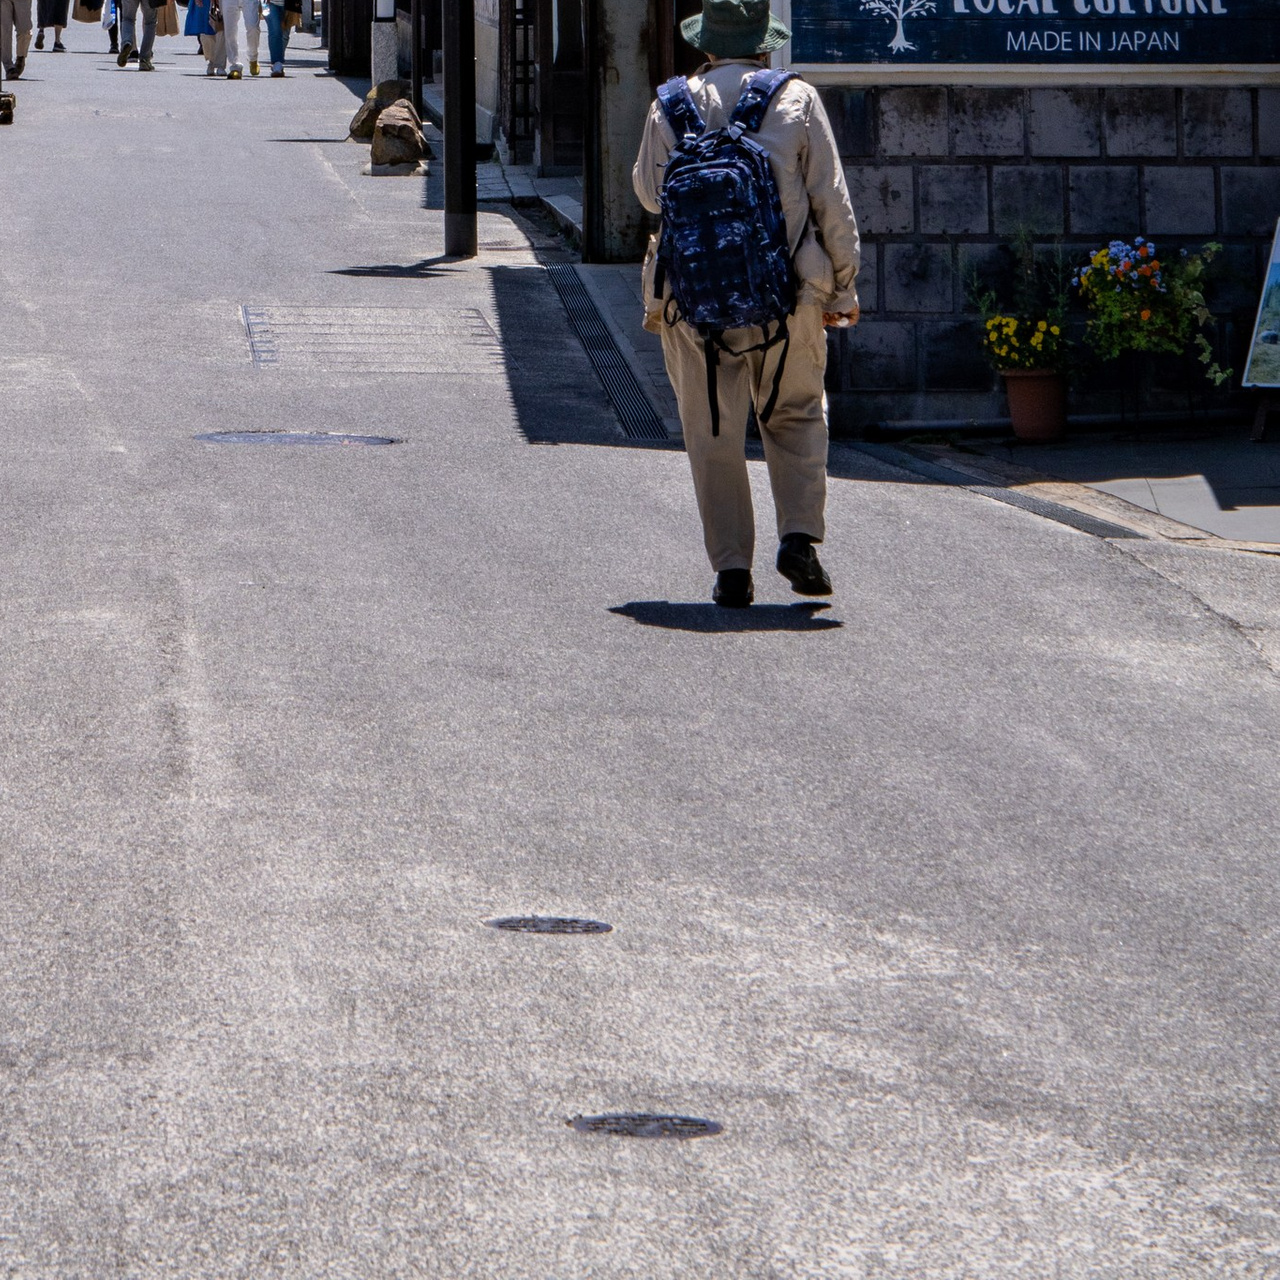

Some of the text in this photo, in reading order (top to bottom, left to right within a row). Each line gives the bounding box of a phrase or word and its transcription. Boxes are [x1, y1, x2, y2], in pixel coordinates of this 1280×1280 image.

[1007, 31, 1180, 53] MADE IN JAPAN
